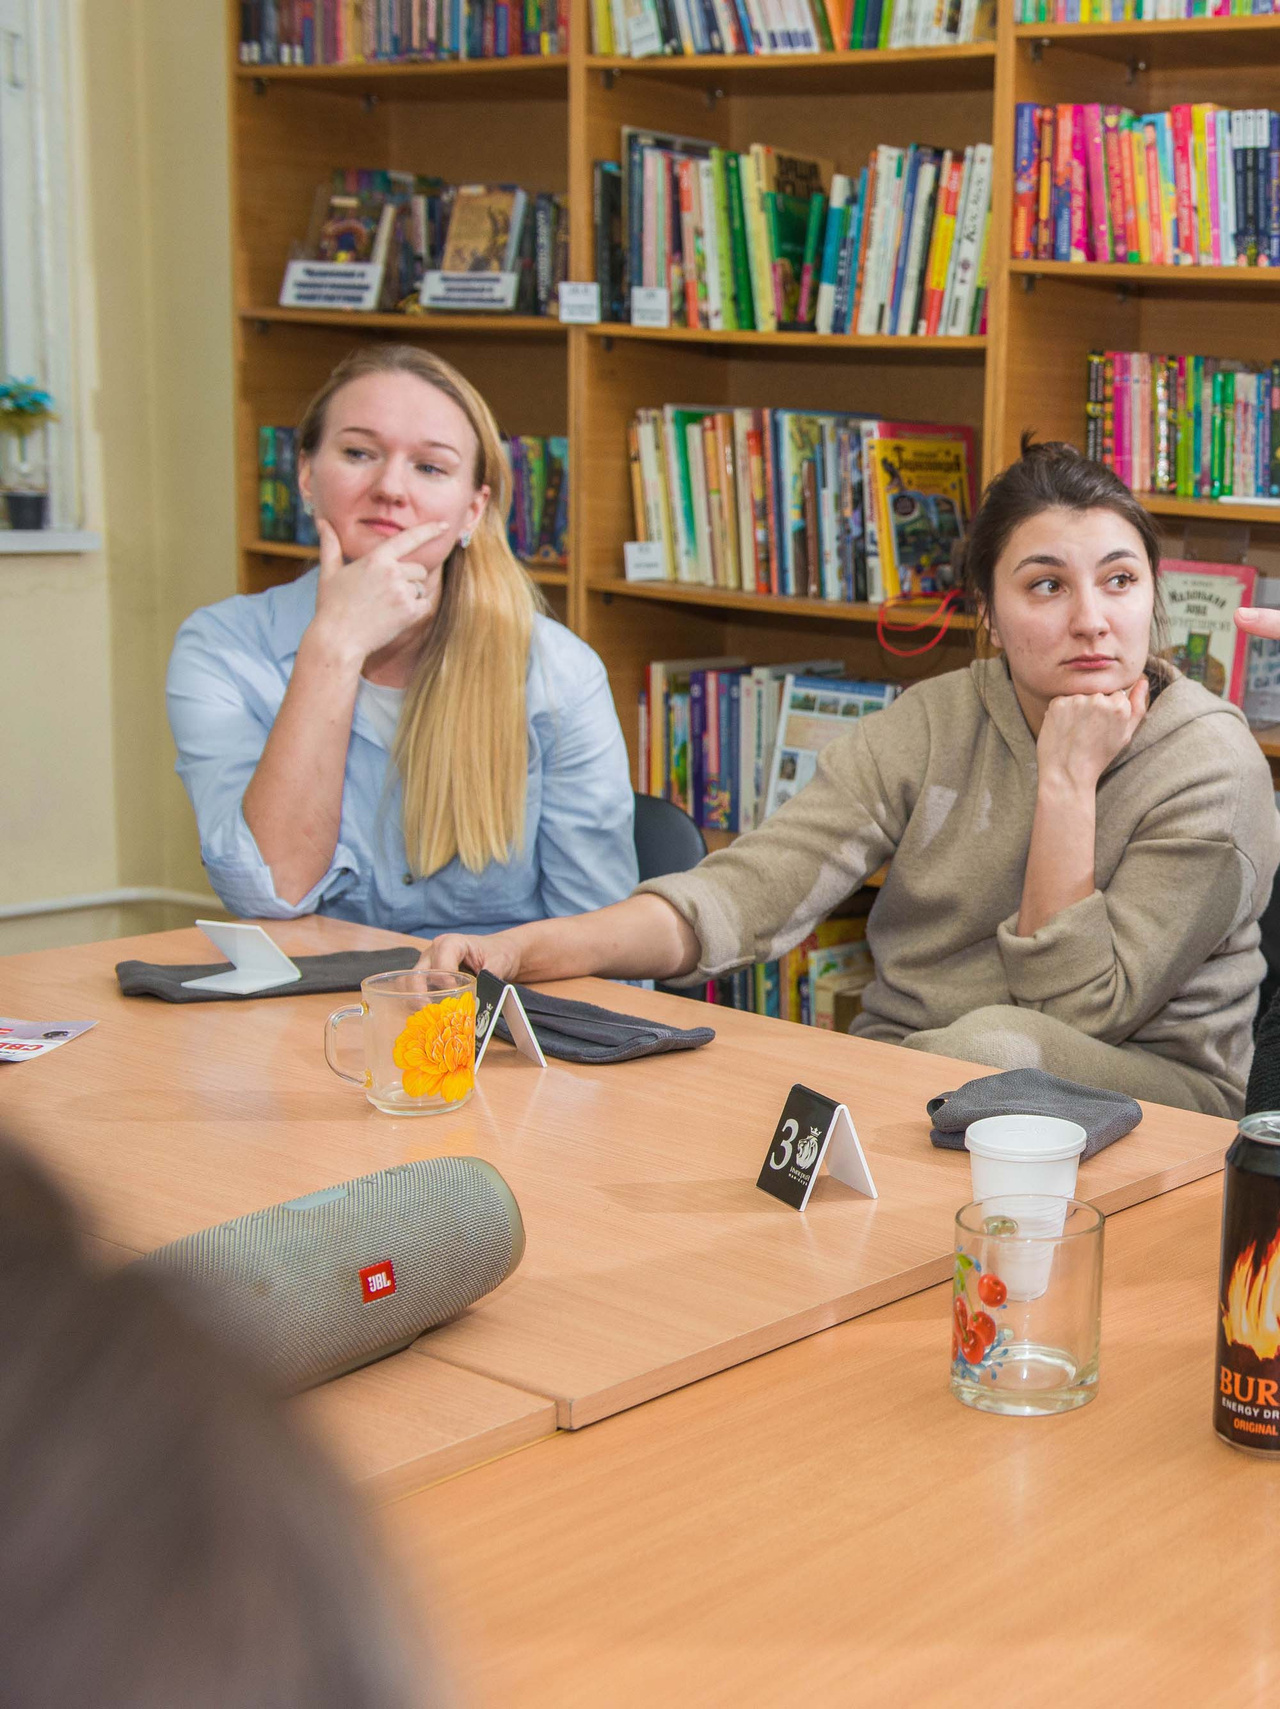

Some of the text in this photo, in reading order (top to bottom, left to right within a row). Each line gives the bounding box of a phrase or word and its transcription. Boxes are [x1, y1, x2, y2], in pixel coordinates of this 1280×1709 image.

[769, 1118, 800, 1171] 3
[367, 1271, 392, 1293] JBL
[1221, 1396, 1260, 1417] ENERGY
[1233, 1418, 1279, 1436] ORIGINAL
